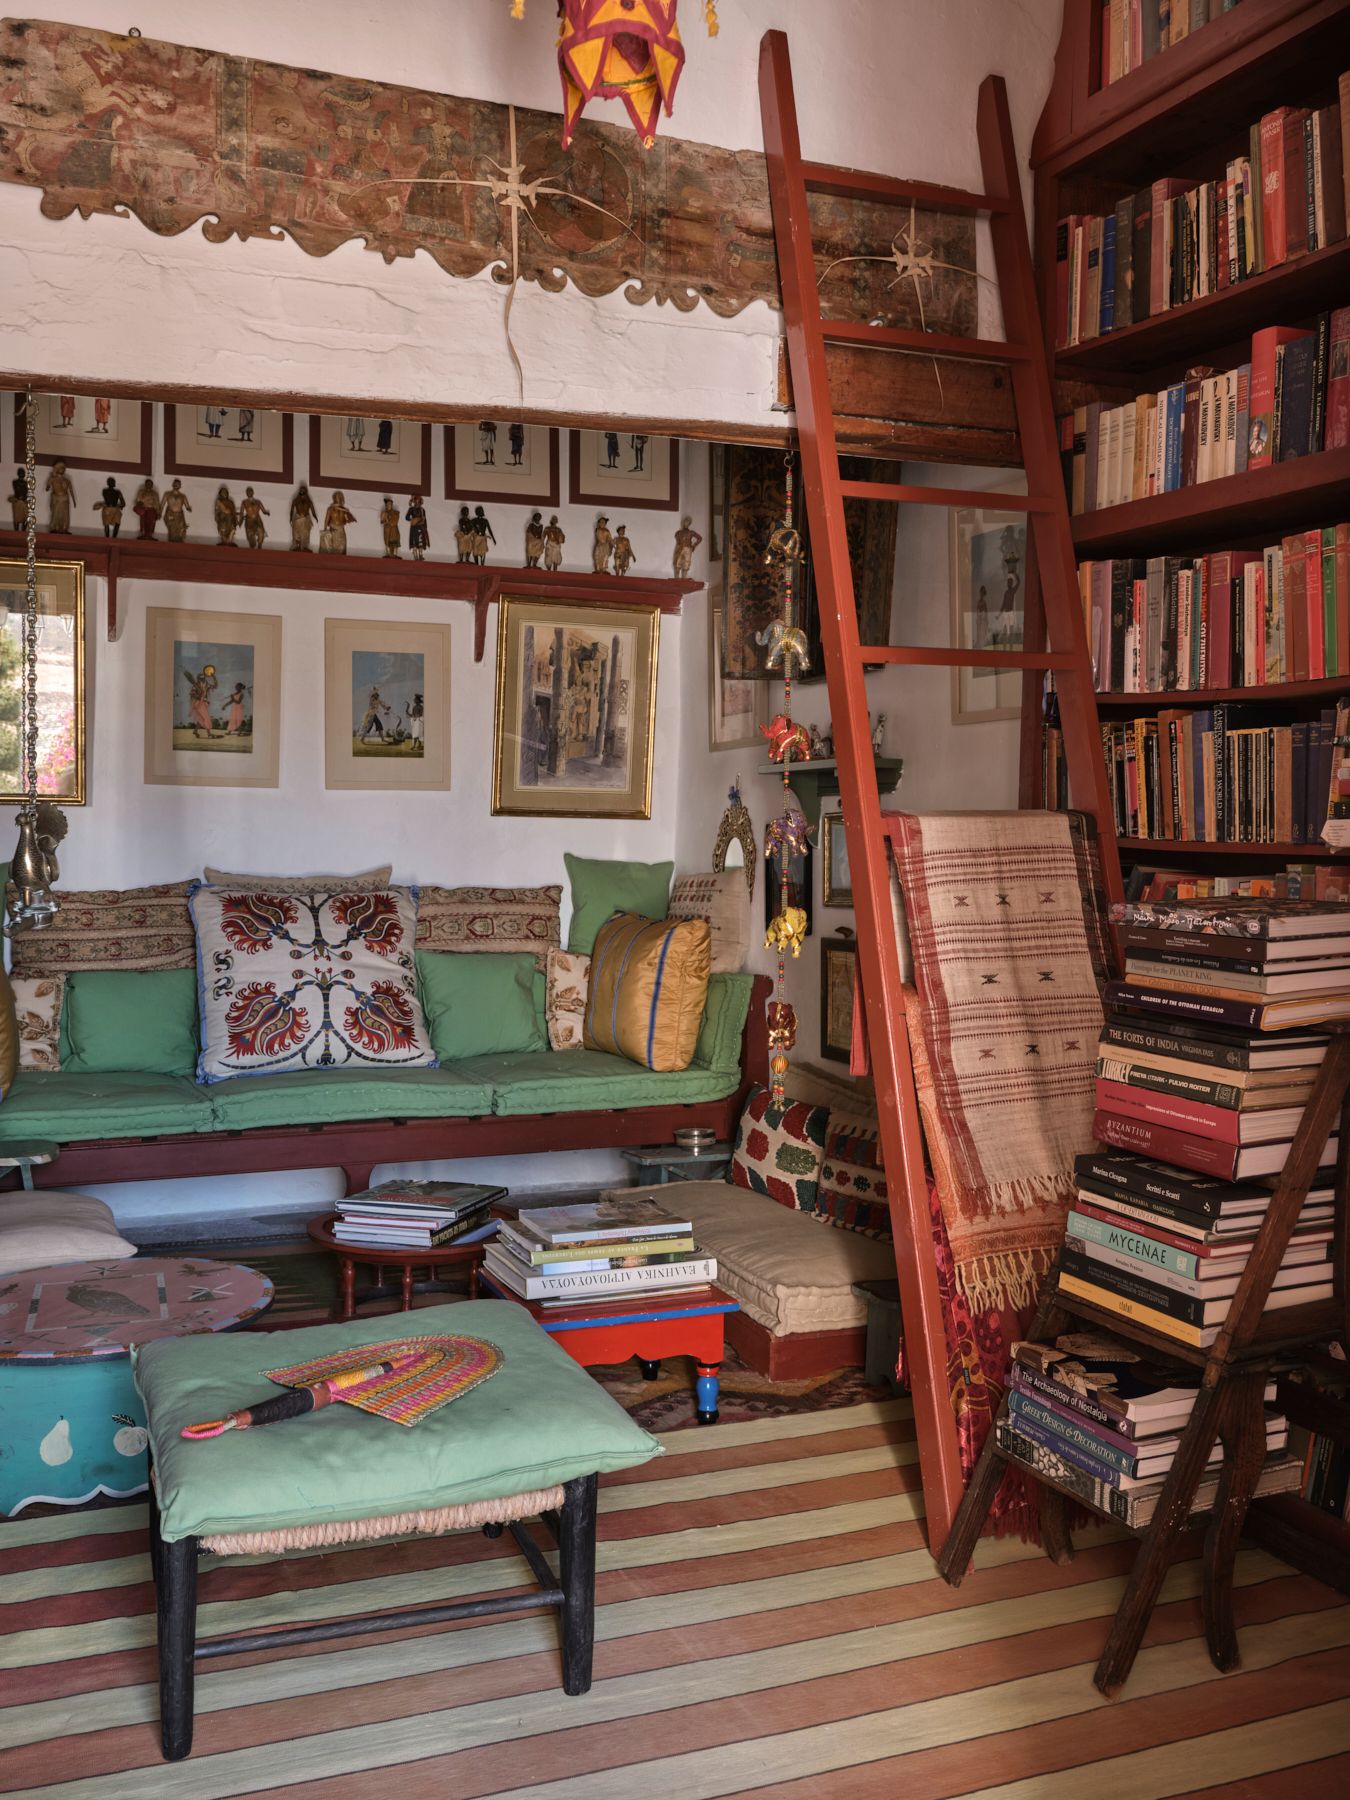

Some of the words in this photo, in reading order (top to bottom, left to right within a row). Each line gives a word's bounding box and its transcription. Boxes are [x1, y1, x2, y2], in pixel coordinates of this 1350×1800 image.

[1216, 810, 1223, 820] IN
[1168, 967, 1196, 978] PLANET
[1196, 970, 1212, 981] KING
[1140, 995, 1161, 1004] CHILDREN
[1178, 1001, 1200, 1010] OTTOMAN
[1200, 1004, 1224, 1014] SERAGLIO
[1109, 1029, 1122, 1040] THE
[1123, 1031, 1144, 1044] FORTS
[1146, 1034, 1156, 1047] OF
[1157, 1038, 1180, 1051] INDIA
[1102, 1059, 1132, 1083] TURKEY
[1129, 1070, 1148, 1080] FREYA
[1168, 1078, 1188, 1088] FULVIO
[1188, 1082, 1211, 1093] ROITER
[1106, 1119, 1152, 1139] BYZANTIUM
[1092, 1166, 1109, 1178] Marina
[1108, 1171, 1128, 1184] Cicogna
[1145, 1183, 1162, 1195] Scritti
[1165, 1190, 1181, 1201] Scatti
[1108, 1231, 1167, 1264] MYCENAE
[541, 1273, 632, 1290] ΑΓΡΙΟΛΟΥΛΟΥΔΑ
[636, 1265, 697, 1281] ΕΛΛΗΝΙΚΑ
[1022, 1371, 1033, 1384] The
[1033, 1377, 1070, 1404] Archaeology
[1078, 1400, 1108, 1421] Nostalgia
[1021, 1401, 1042, 1420] GREEK
[1041, 1410, 1065, 1434] DESIGN
[1065, 1426, 1073, 1437] &
[1073, 1429, 1118, 1463] DECORATION
